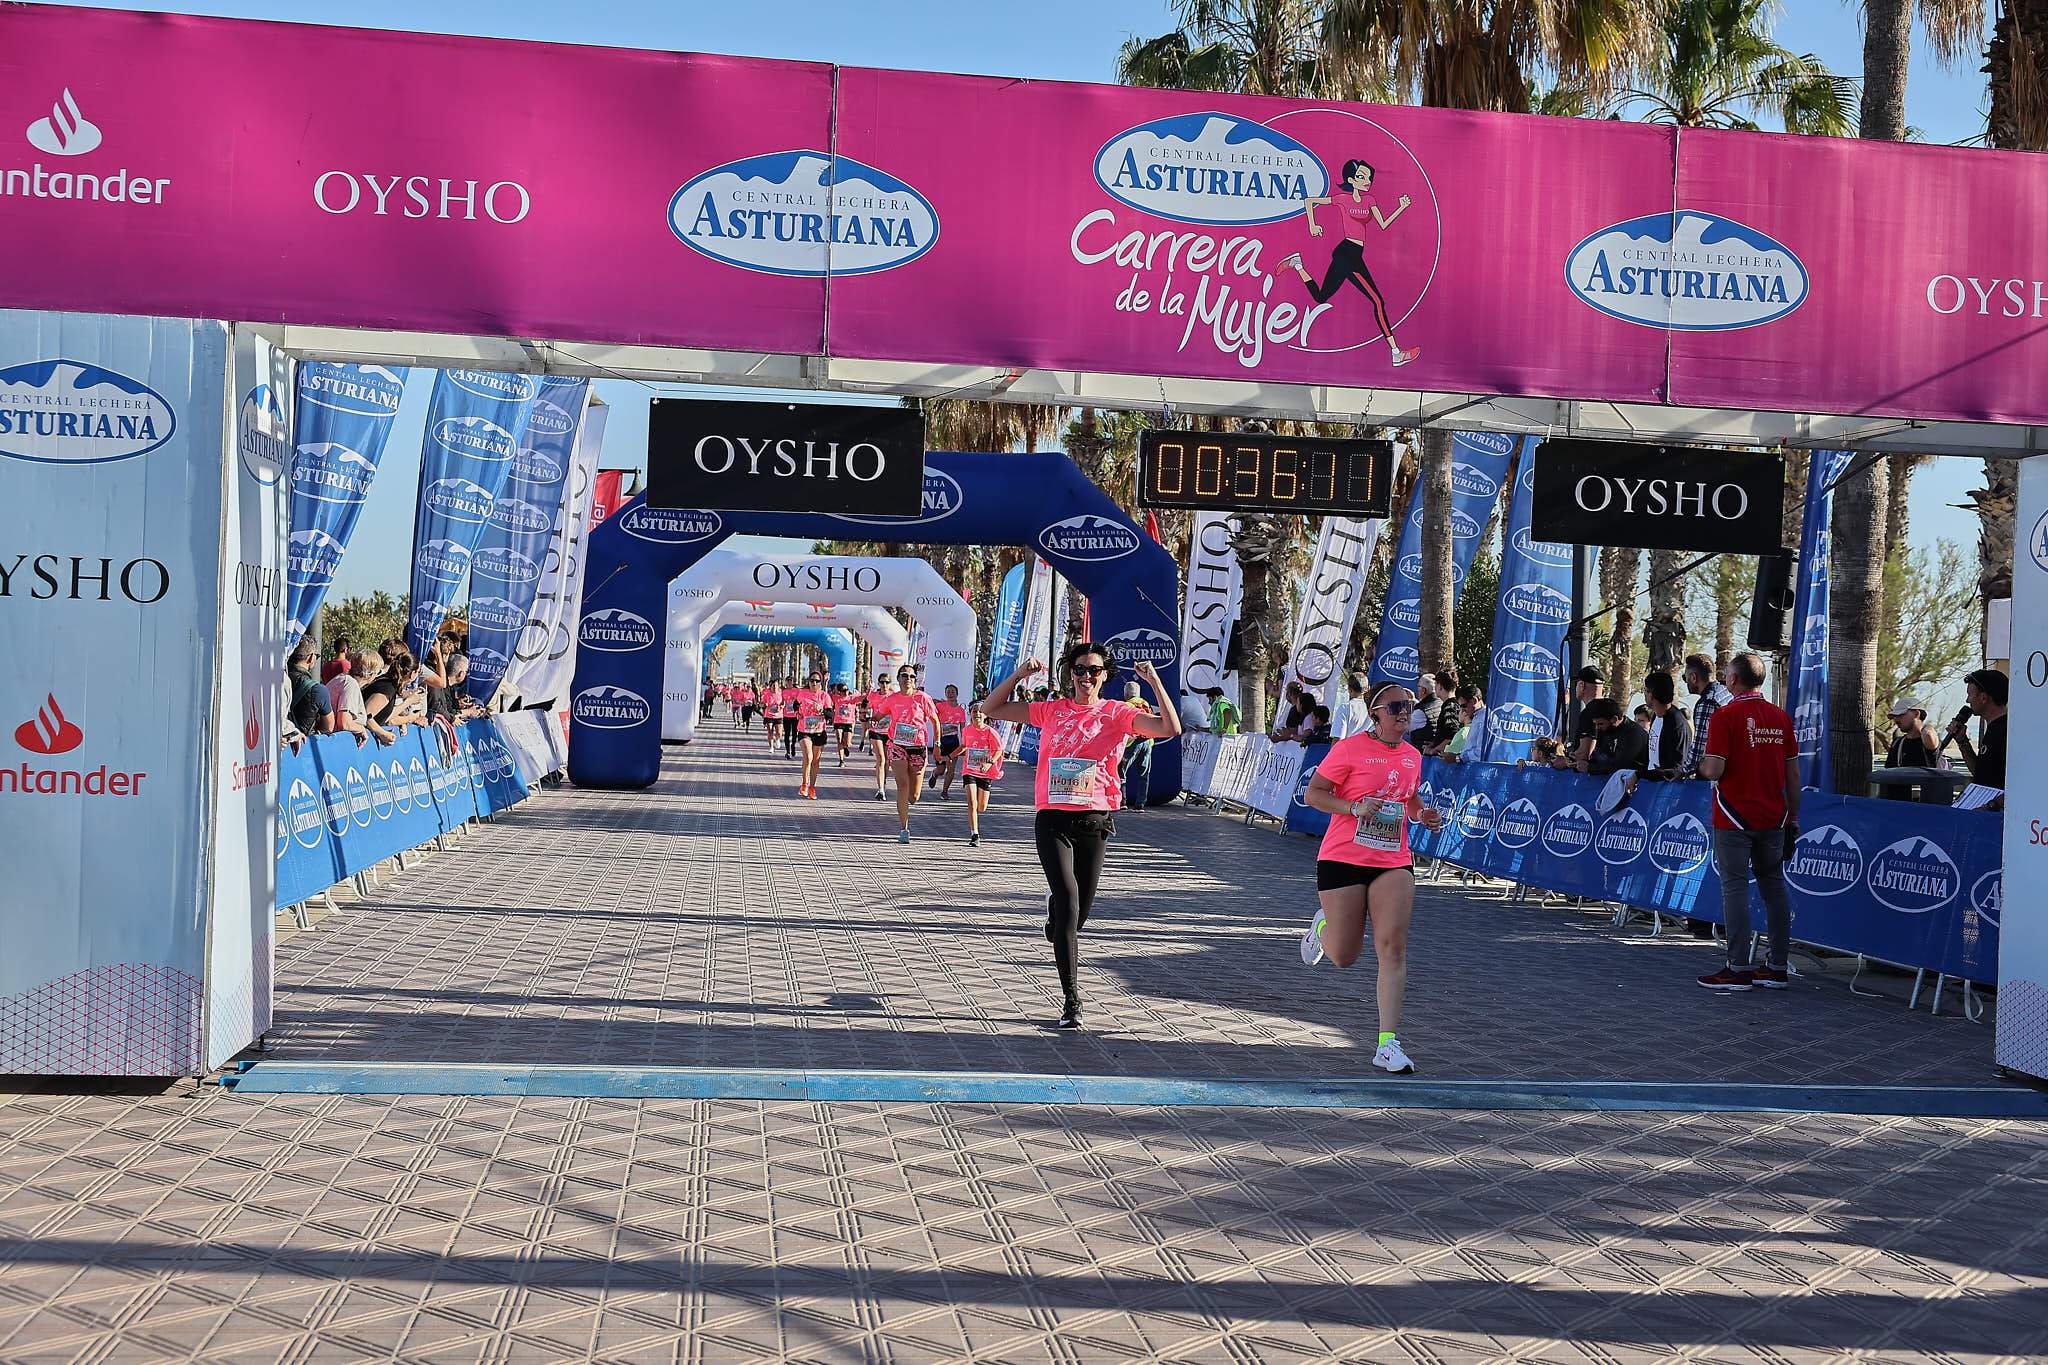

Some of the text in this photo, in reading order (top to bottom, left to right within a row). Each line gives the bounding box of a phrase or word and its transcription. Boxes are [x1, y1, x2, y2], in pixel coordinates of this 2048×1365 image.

[1149, 147, 1305, 169] CENTRAL LECHERA
[1111, 147, 1311, 201] ASTURIANA
[313, 170, 531, 224] OYSHO
[732, 190, 910, 211] CENTRAL LECHERA
[688, 191, 918, 248] ASTURIANA
[1070, 208, 1264, 277] Carrera
[1622, 249, 1784, 269] CENTRAL LECHERA
[1583, 248, 1790, 304] ASTURIANA
[1926, 273, 2048, 318] OYSH
[1114, 272, 1334, 368] de la Mujer
[299, 364, 400, 410] ASTURIANA
[315, 367, 356, 381] CENTRAL
[452, 368, 528, 398] ASTURIANA
[79, 397, 152, 410] LECHERA
[438, 423, 511, 457] ASTURIANA
[694, 434, 886, 482] OYSHO
[1157, 443, 1374, 502] 00:36:11
[1574, 474, 1749, 521] OYSHO
[626, 514, 714, 534] ASTURIANA
[1047, 531, 1133, 549] ASTURIANA
[473, 554, 534, 579] ASTURIANA
[752, 562, 881, 592] OYSHO
[235, 561, 281, 610] OYSHO
[675, 588, 714, 599] OYSHO
[917, 597, 954, 606] OYSHO
[1186, 521, 1233, 695] OYSHO
[1296, 516, 1367, 686] OYSH
[1508, 592, 1571, 620] ASTURIANA
[580, 623, 650, 643] ASTURIANA
[934, 651, 969, 660] OYSHO
[576, 700, 645, 719] ASTURIANA
[665, 692, 689, 702] SHO
[0, 763, 147, 796] ntander
[232, 760, 272, 791] Santander
[1259, 750, 1296, 786] OYSHO
[1545, 821, 1588, 846] ASTURIANA
[1599, 826, 1642, 852] ASTURIANA
[1652, 832, 1704, 861] ASTURIANA
[1786, 848, 1855, 881] ASTURIANA
[1872, 859, 1948, 898] ASTURIANA
